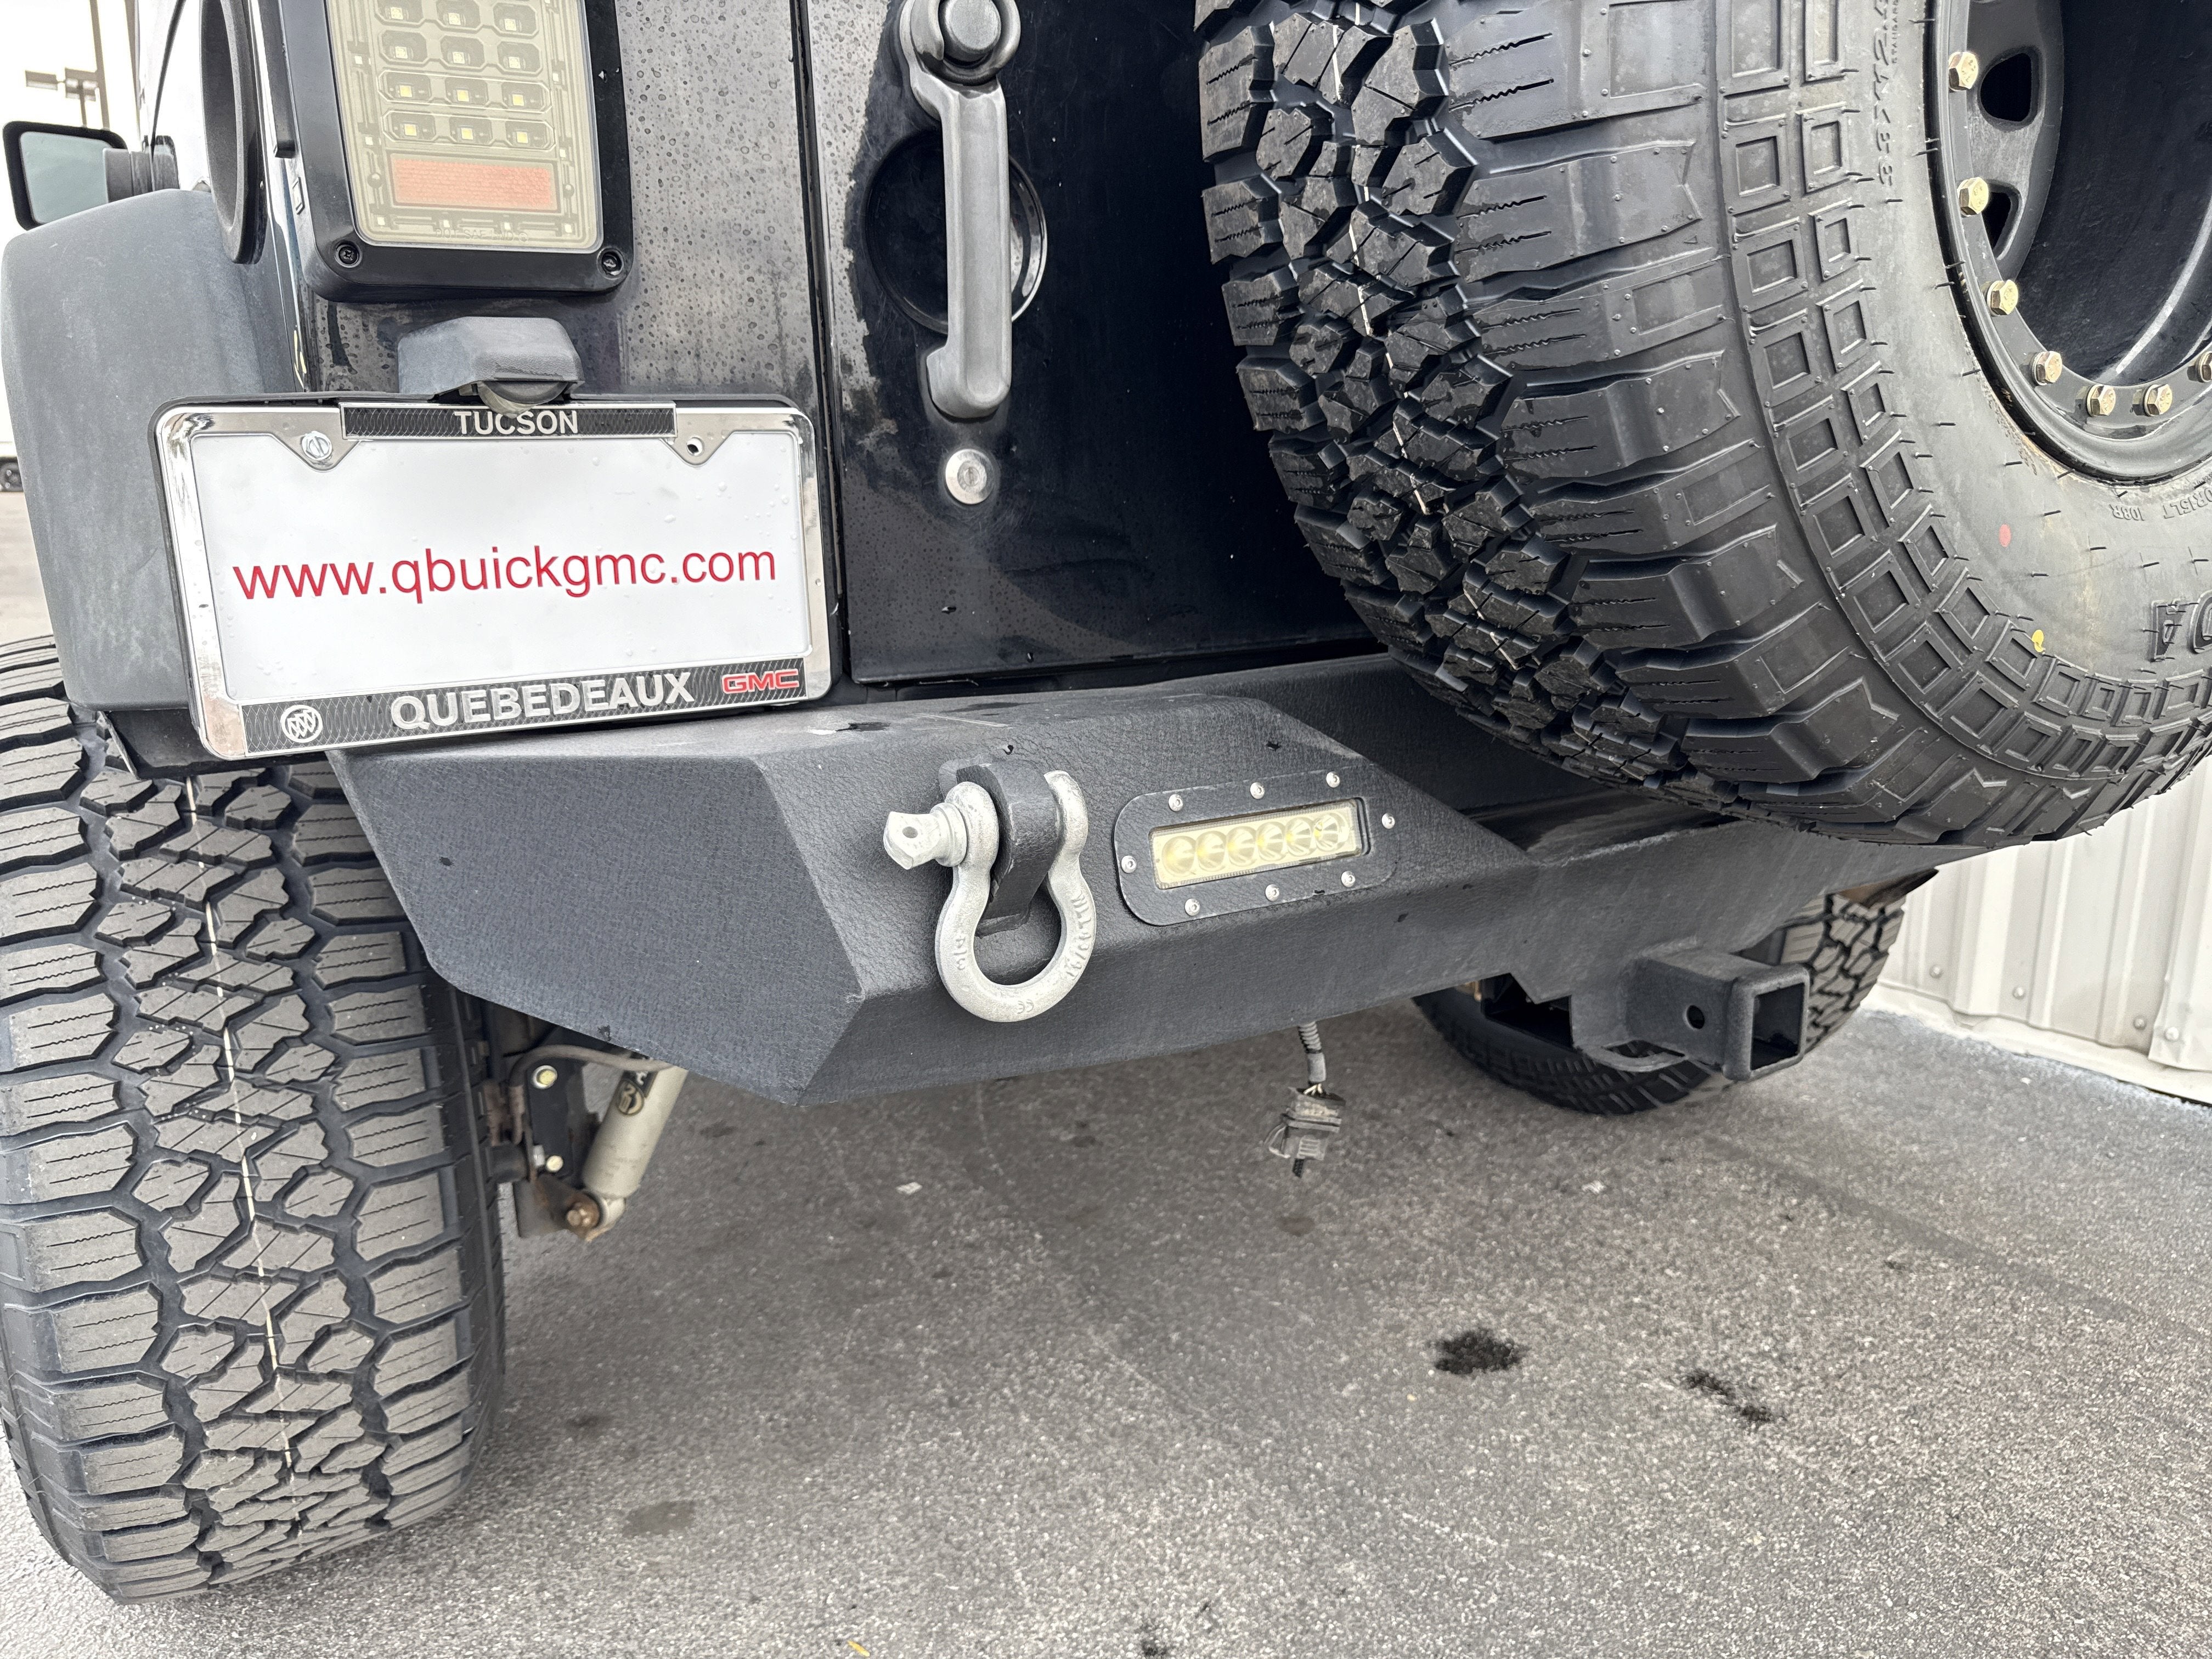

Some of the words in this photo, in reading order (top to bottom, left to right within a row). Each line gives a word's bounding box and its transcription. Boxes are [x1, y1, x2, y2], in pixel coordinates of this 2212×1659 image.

[454, 410, 578, 435] TUCSON
[2109, 504, 2145, 521] 108R
[233, 545, 776, 604] www.qbuickgmc.com
[722, 669, 800, 695] GMC
[390, 672, 695, 730] QUEBEDEAUX
